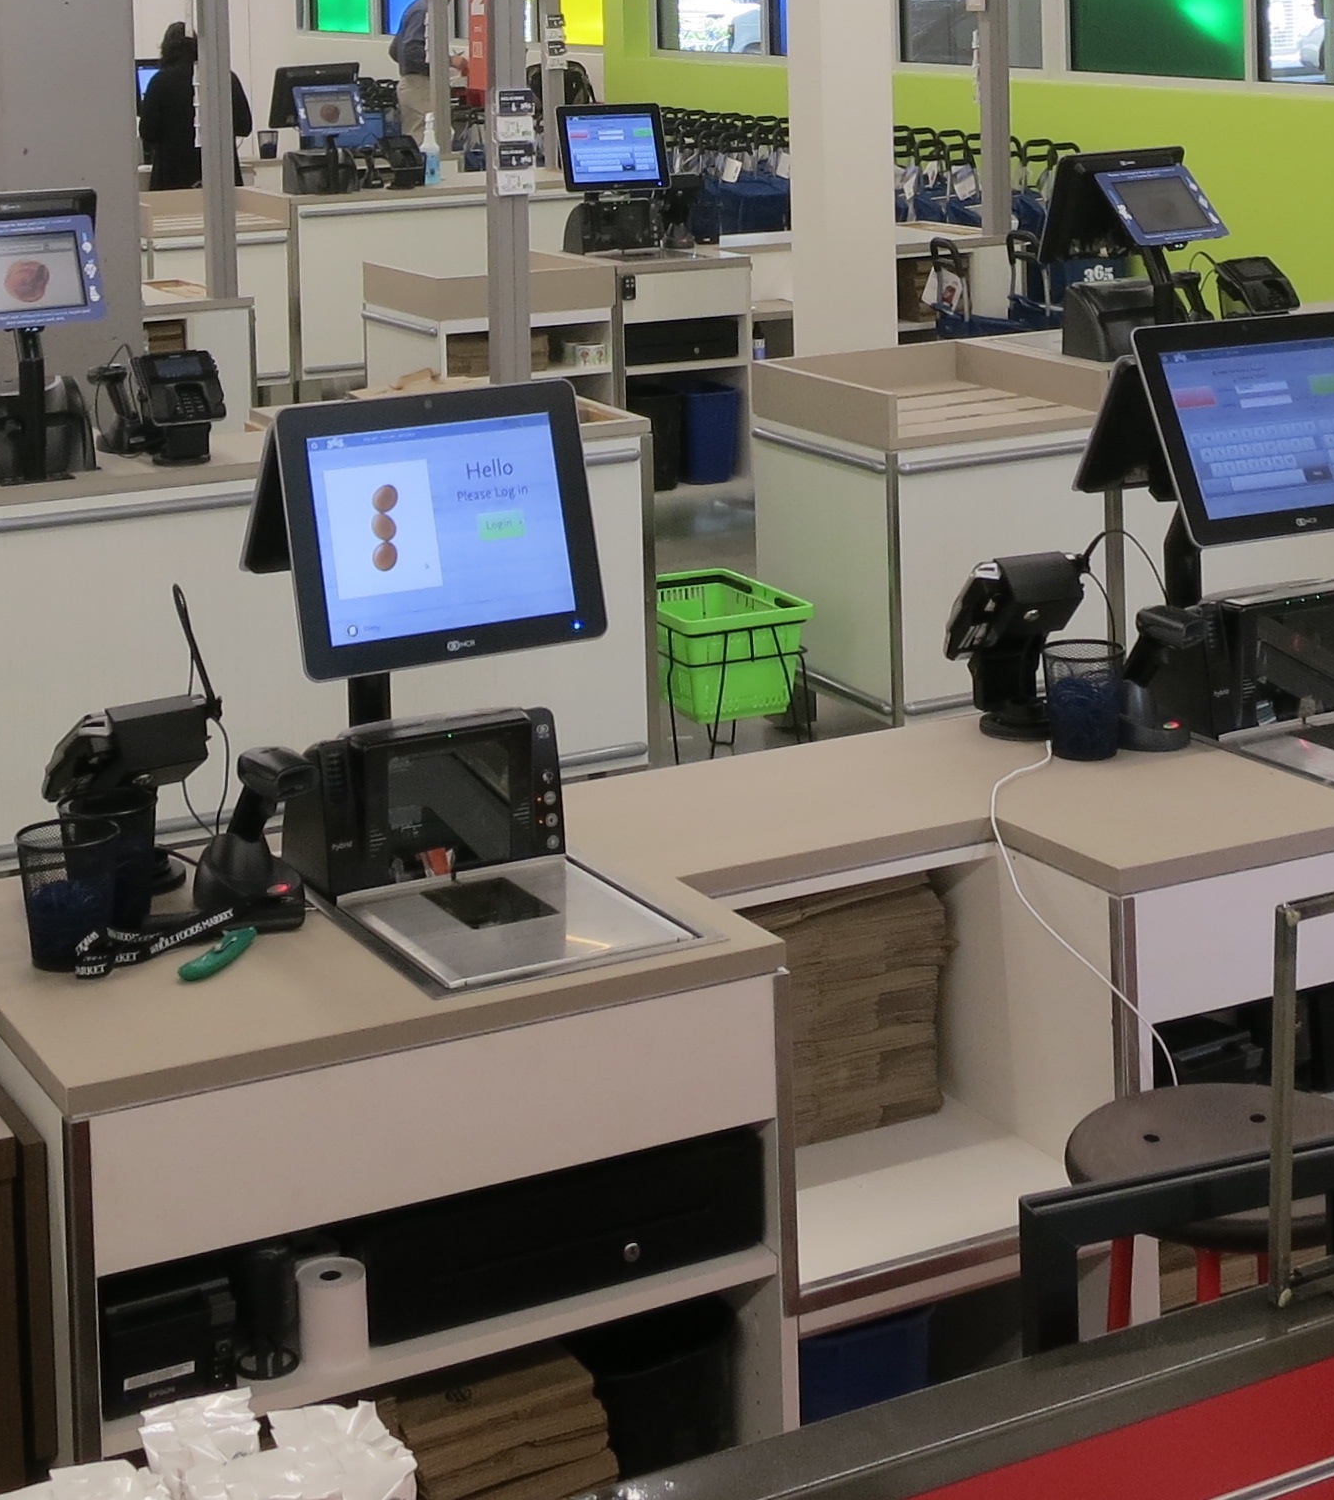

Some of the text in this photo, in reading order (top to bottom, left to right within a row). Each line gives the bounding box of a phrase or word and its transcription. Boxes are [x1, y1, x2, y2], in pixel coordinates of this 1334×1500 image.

[1083, 264, 1115, 283] 365
[466, 457, 515, 480] Hello
[456, 484, 529, 502] Please Log in
[485, 519, 513, 531] Login
[174, 921, 203, 944] FOODS
[202, 907, 234, 931] MARKET
